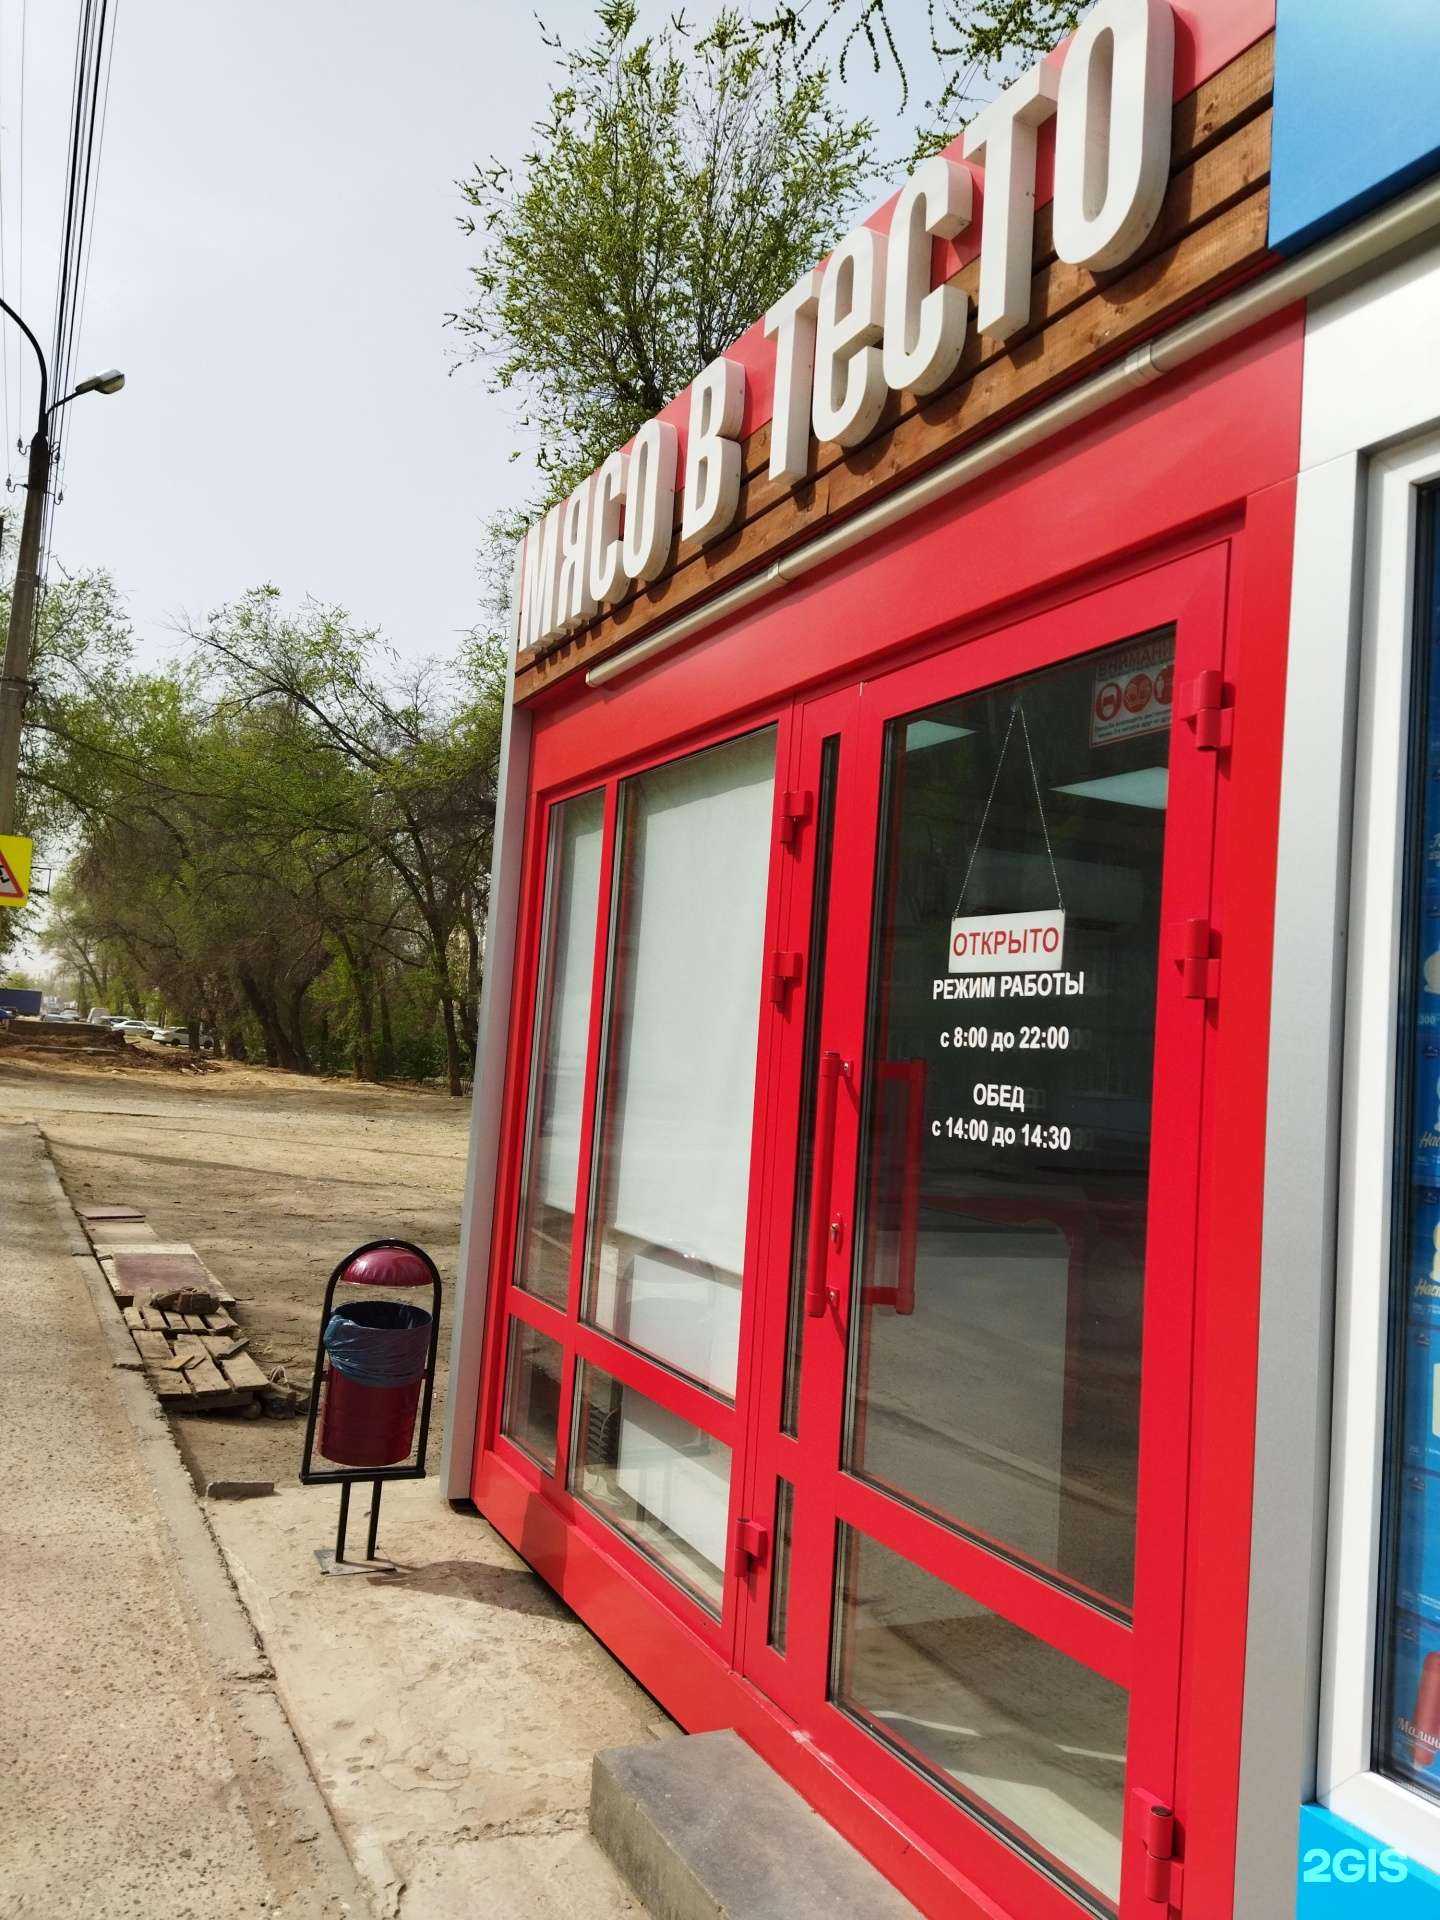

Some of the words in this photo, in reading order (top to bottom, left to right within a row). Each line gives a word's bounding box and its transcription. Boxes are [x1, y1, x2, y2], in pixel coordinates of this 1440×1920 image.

[519, 418, 678, 654] МЯСО
[681, 357, 746, 546] В
[953, 927, 1059, 956] ОТКРЫТО
[933, 977, 995, 1000] РЕЖИМ
[1000, 971, 1084, 997] РАБОТЫ
[940, 1032, 949, 1048] с
[953, 1027, 988, 1048] 8:00
[991, 1033, 1014, 1052] до
[1019, 1026, 1069, 1049] 22:00
[973, 1083, 1025, 1112] ОБЕД
[931, 1121, 941, 1137] с
[945, 1117, 988, 1142] 14:00
[991, 1127, 1016, 1147] до
[1021, 1124, 1071, 1151] 14:30
